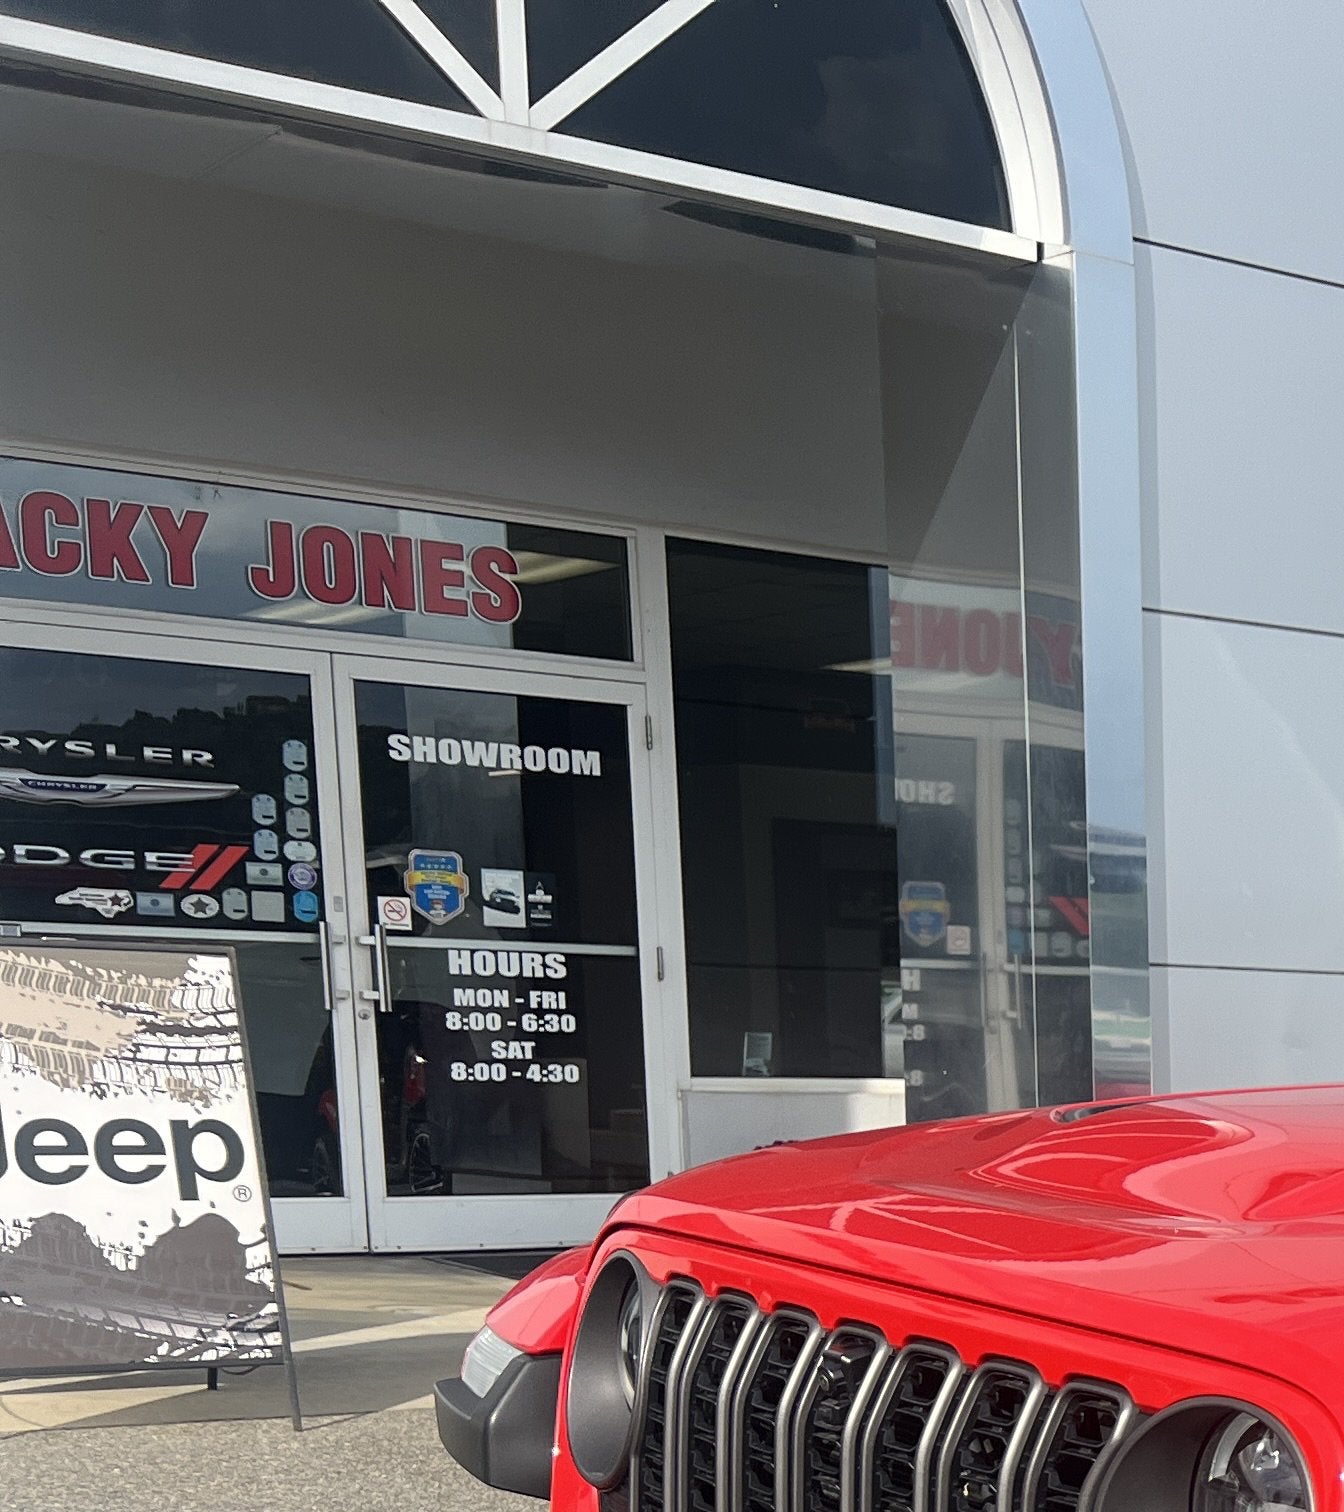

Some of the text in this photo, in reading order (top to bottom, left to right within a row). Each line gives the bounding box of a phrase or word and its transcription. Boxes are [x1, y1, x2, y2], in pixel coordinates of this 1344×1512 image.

[248, 518, 521, 623] JONES
[388, 733, 602, 776] SHOWROOM
[0, 844, 196, 873] DGE
[447, 949, 568, 979] HOURS
[453, 988, 510, 1009] MON
[529, 990, 567, 1009] FRI
[446, 1011, 502, 1031] 8:00
[521, 1013, 576, 1032] 6:30
[491, 1040, 536, 1060] SAT
[450, 1062, 507, 1082] 8:00
[526, 1063, 580, 1083] 4:30
[0, 1110, 245, 1201] eep
